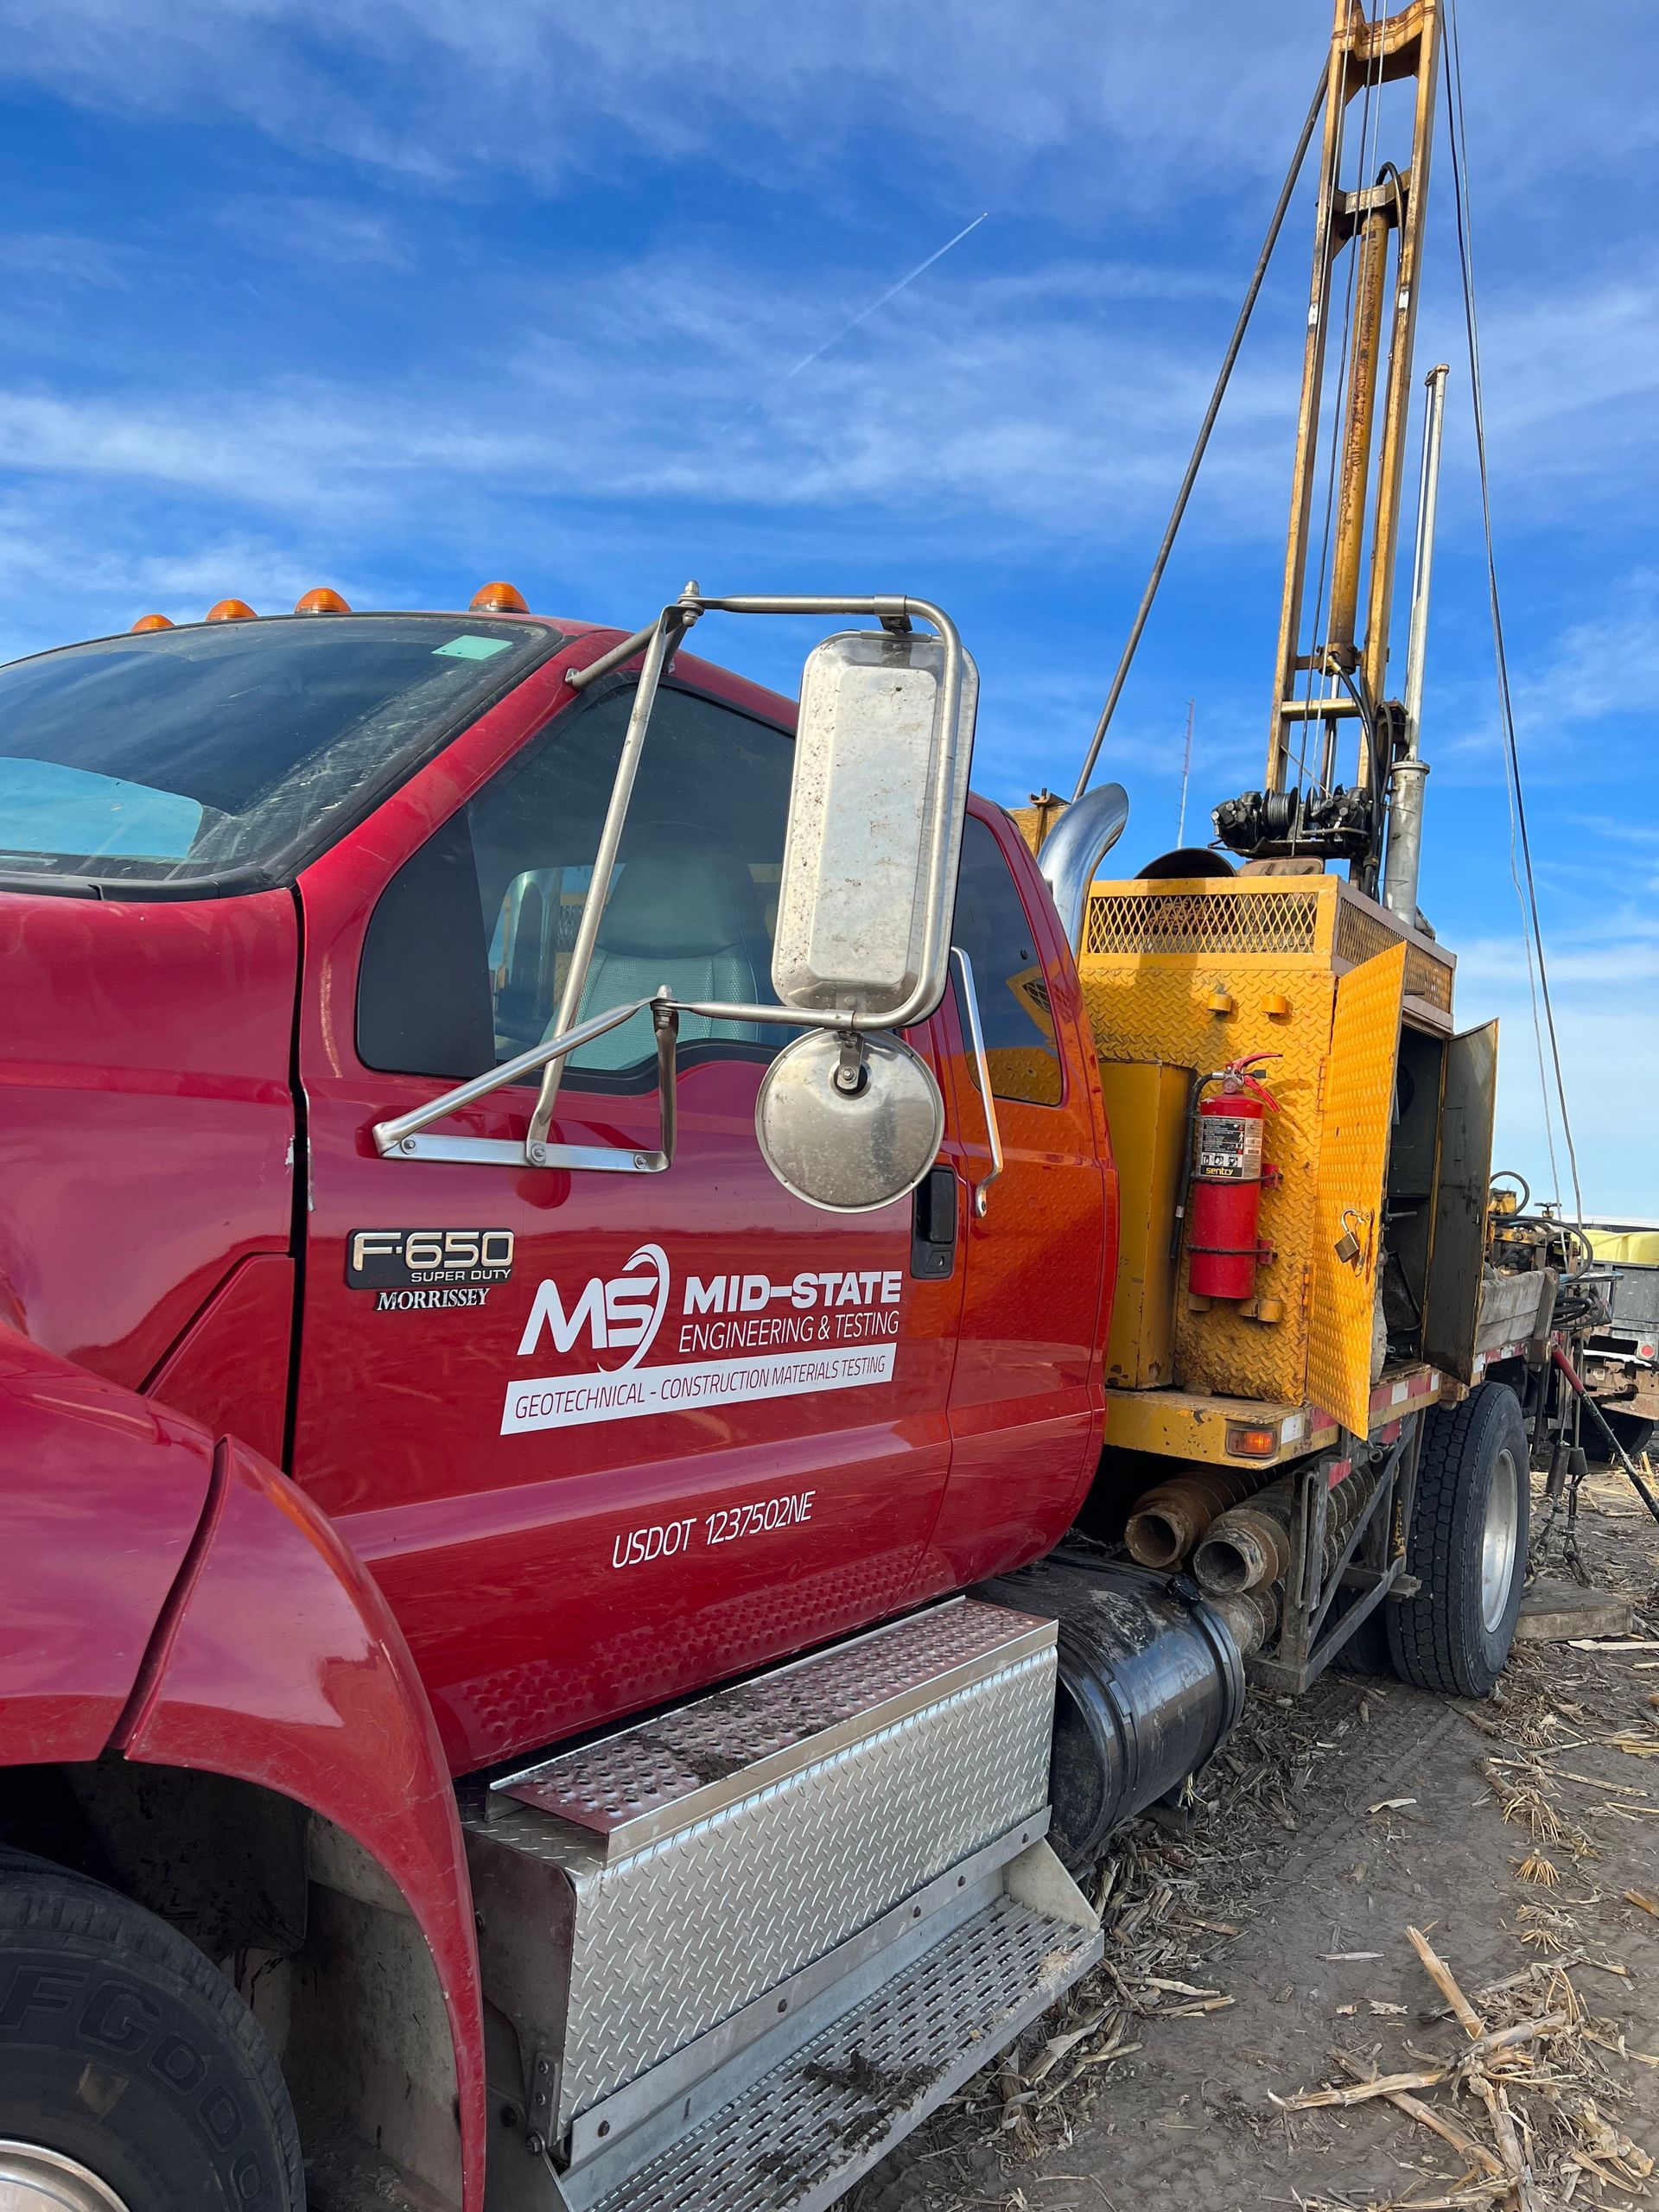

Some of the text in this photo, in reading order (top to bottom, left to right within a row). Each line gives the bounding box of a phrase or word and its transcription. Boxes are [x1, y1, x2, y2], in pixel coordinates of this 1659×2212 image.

[1205, 1166, 1234, 1175] sentry
[410, 1269, 512, 1282] SUPER DUTY
[683, 1270, 903, 1315] MID-STATE
[376, 1287, 491, 1311] MORRISSEY
[678, 1310, 900, 1353] ENGINEERING & TESTING
[515, 1382, 645, 1419] GEOTECHNICAL
[661, 1369, 771, 1400] CONSTRUCTION
[772, 1360, 839, 1384] MATERIALS
[842, 1355, 887, 1378] TESTING
[612, 1490, 816, 1568] USDOT 1237502NE
